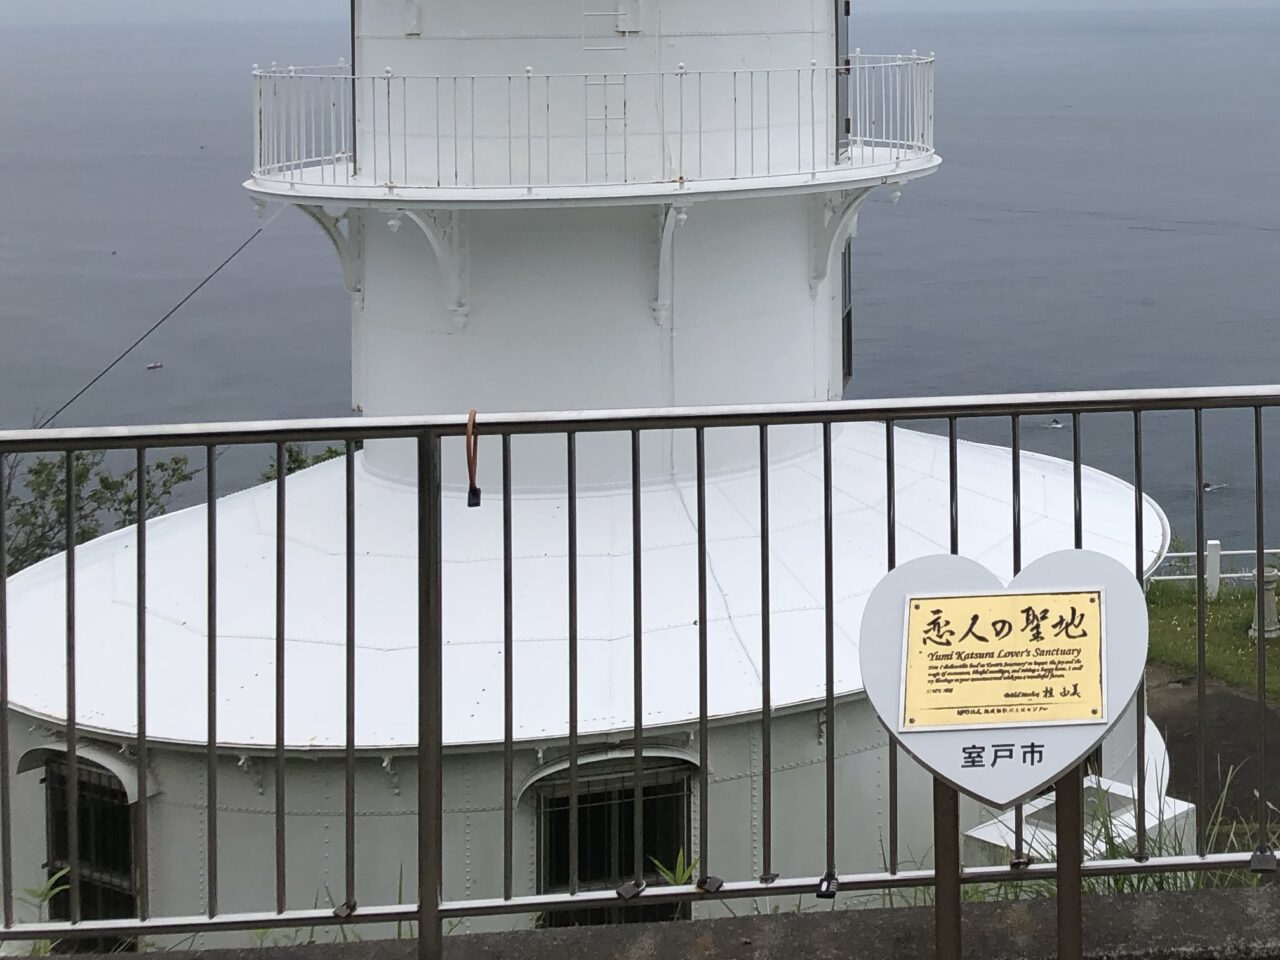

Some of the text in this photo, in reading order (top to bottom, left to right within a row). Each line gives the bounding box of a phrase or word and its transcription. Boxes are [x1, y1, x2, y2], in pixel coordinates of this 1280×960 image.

[922, 606, 1088, 647] 恋人の聖地
[927, 647, 1082, 661] Yumi Katsura Lover's Sanctuary
[961, 742, 1045, 769] 室戸市
